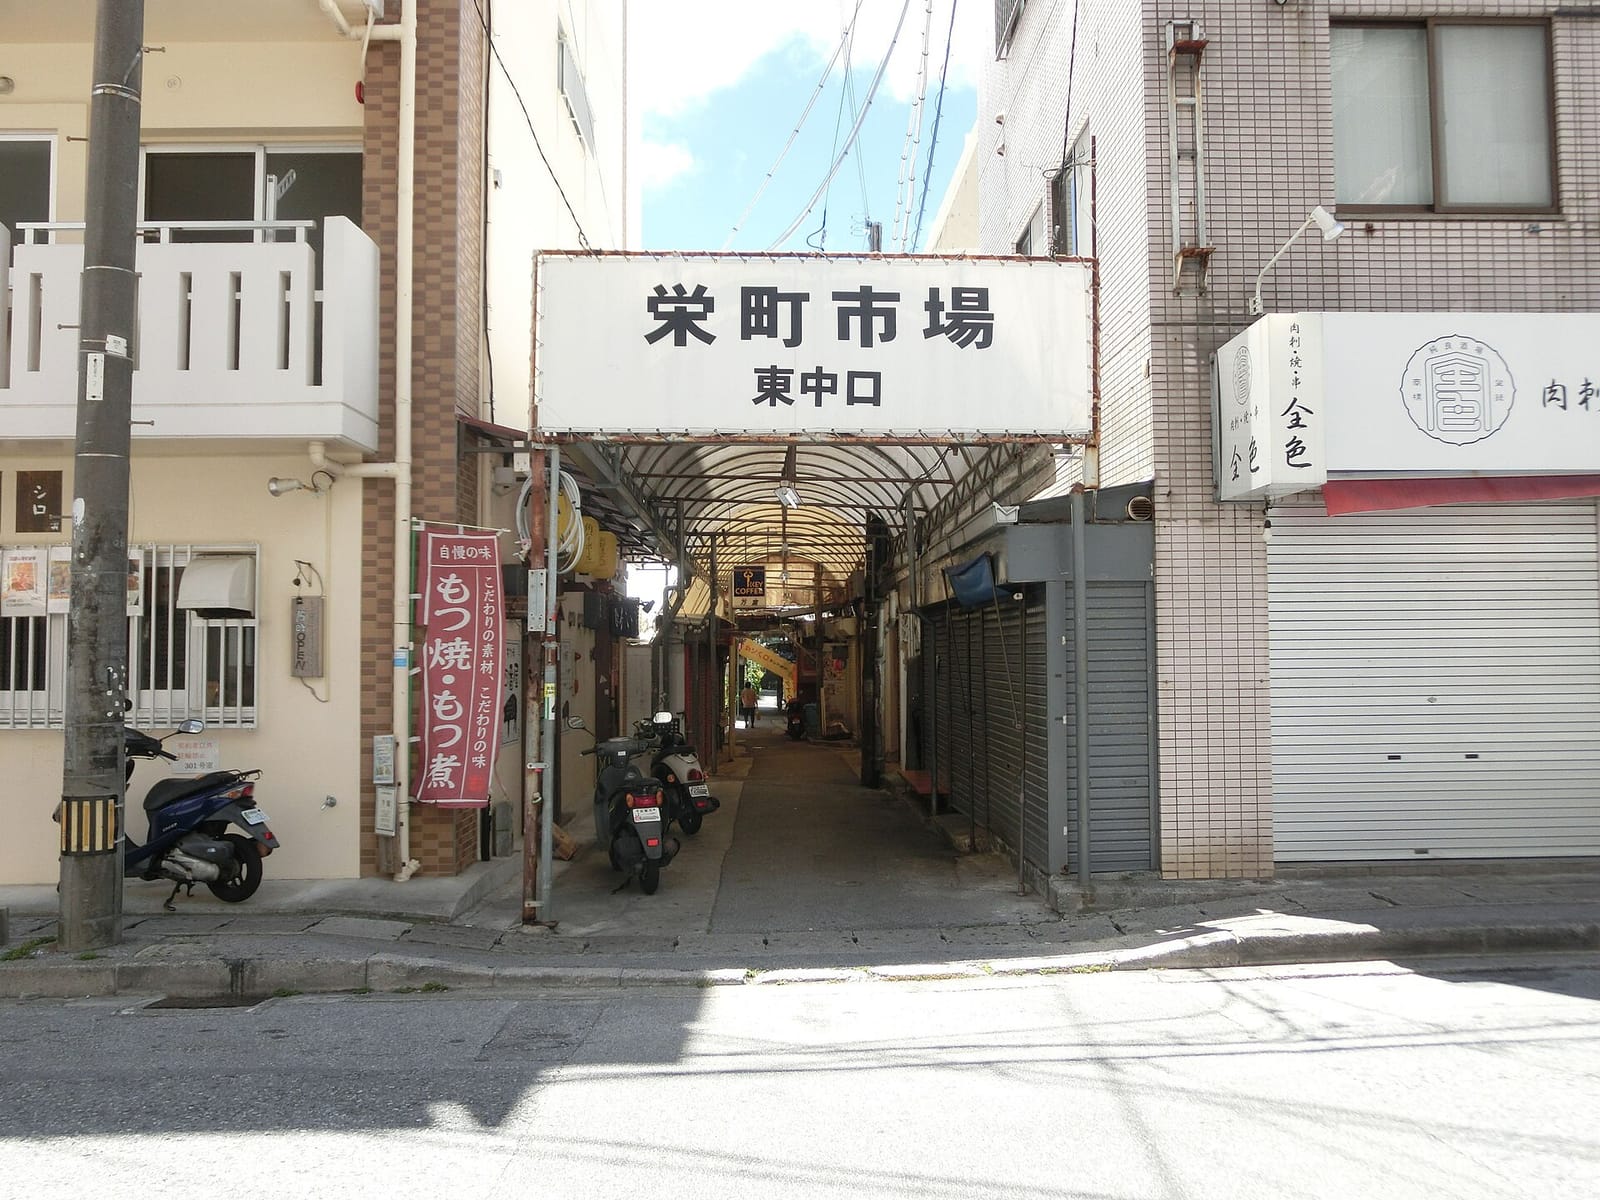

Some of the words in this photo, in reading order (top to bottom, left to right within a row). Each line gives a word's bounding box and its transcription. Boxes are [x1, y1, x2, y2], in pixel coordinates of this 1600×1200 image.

[643, 283, 995, 350] 栄町市場
[752, 365, 882, 407] 東中口
[1231, 435, 1259, 482] 全色
[1281, 396, 1314, 469] 全色
[439, 544, 493, 561] 自慢の味
[427, 572, 474, 789] もつ焼・もつ煮
[471, 575, 496, 769] こだわりの素材、こだわりの味
